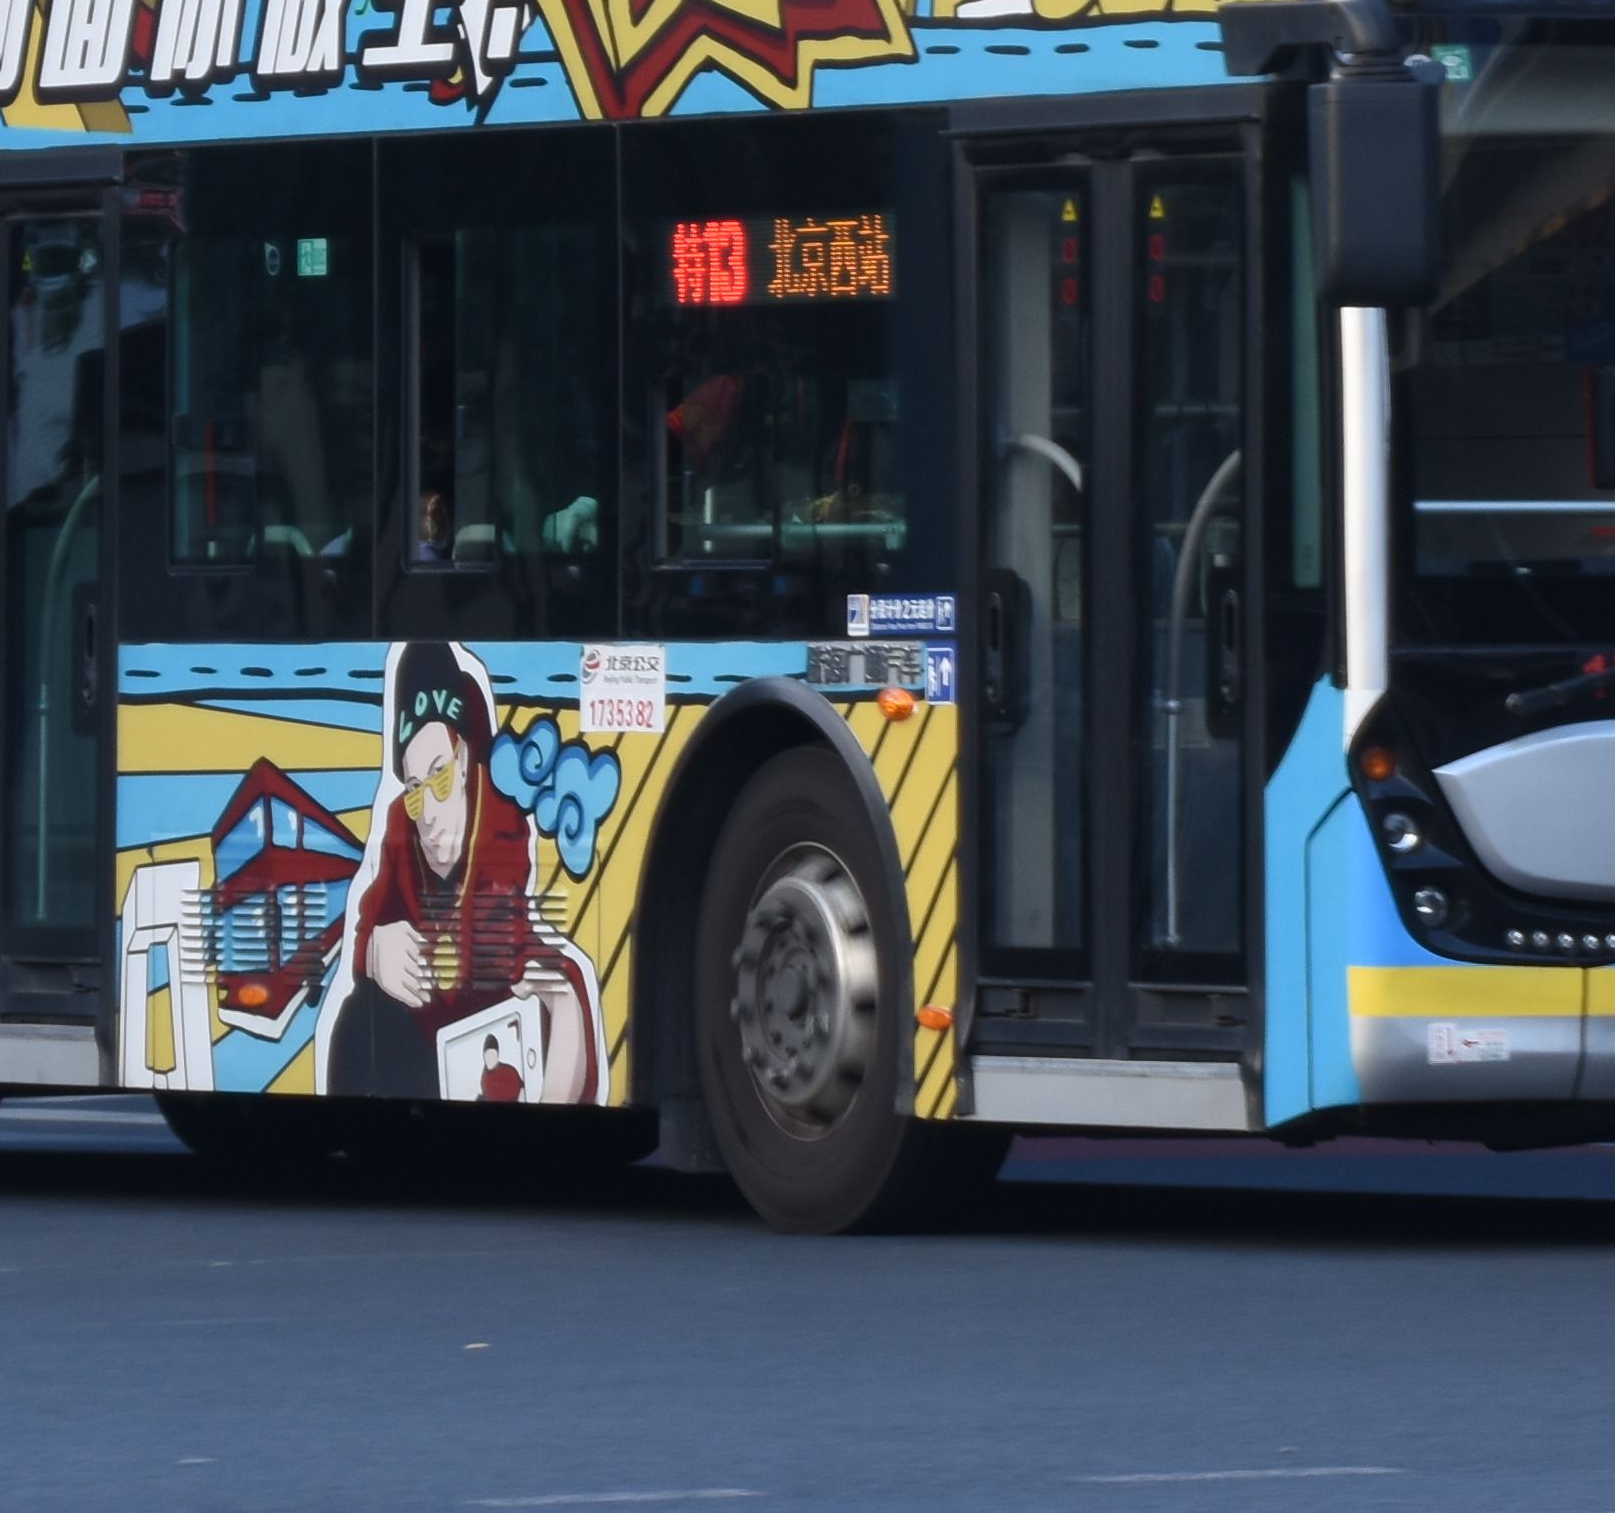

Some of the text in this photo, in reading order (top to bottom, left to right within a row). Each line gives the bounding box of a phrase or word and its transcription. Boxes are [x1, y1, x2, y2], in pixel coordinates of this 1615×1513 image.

[672, 213, 890, 304] 特13 北京西站
[604, 654, 661, 672] 北京公交
[399, 689, 463, 744] LOVE
[589, 699, 654, 729] 1735382
